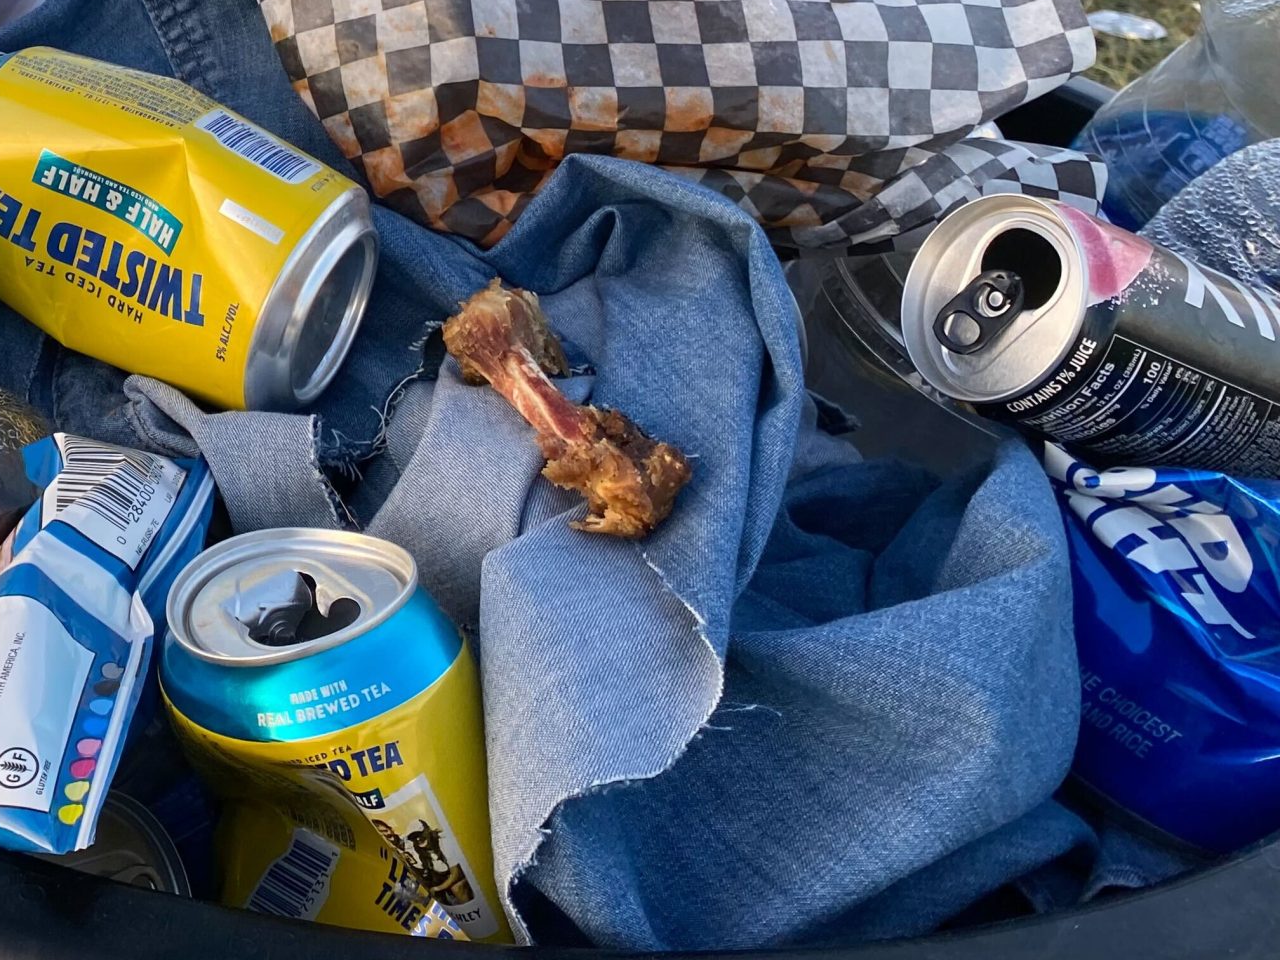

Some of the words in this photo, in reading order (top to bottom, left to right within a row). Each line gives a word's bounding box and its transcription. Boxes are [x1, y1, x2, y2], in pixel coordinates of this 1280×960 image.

[41, 164, 101, 203] HALF
[105, 192, 123, 211] &
[125, 204, 174, 250] HALF
[24, 255, 56, 277] TEA
[46, 221, 205, 327] TWISTED
[65, 271, 102, 299] ICED
[107, 293, 143, 324] HARD
[215, 345, 226, 362] 5%
[1006, 381, 1062, 413] CONTAINS
[1055, 369, 1076, 385] 1%
[1069, 337, 1098, 372] JUICE
[1081, 362, 1116, 397] Facts
[1143, 361, 1161, 384] 100
[1147, 386, 1163, 403] Daily
[116, 536, 127, 545] 0
[127, 483, 155, 523] 28400
[0, 646, 23, 682] AMERICA,
[13, 631, 28, 647] INC.
[257, 710, 293, 728] REAL
[295, 693, 361, 724] BREWED
[361, 681, 392, 703] TEA
[289, 689, 319, 705] MADE
[320, 679, 348, 698] WITH
[1098, 686, 1183, 744] CHOICEST
[304, 752, 328, 764] ICED
[332, 744, 353, 756] TEA
[1113, 721, 1154, 759] RICE
[14, 752, 28, 762] F
[351, 741, 404, 778] TEA
[6, 773, 21, 783] G
[35, 770, 48, 796] GLUTEN
[353, 794, 380, 808] ALF
